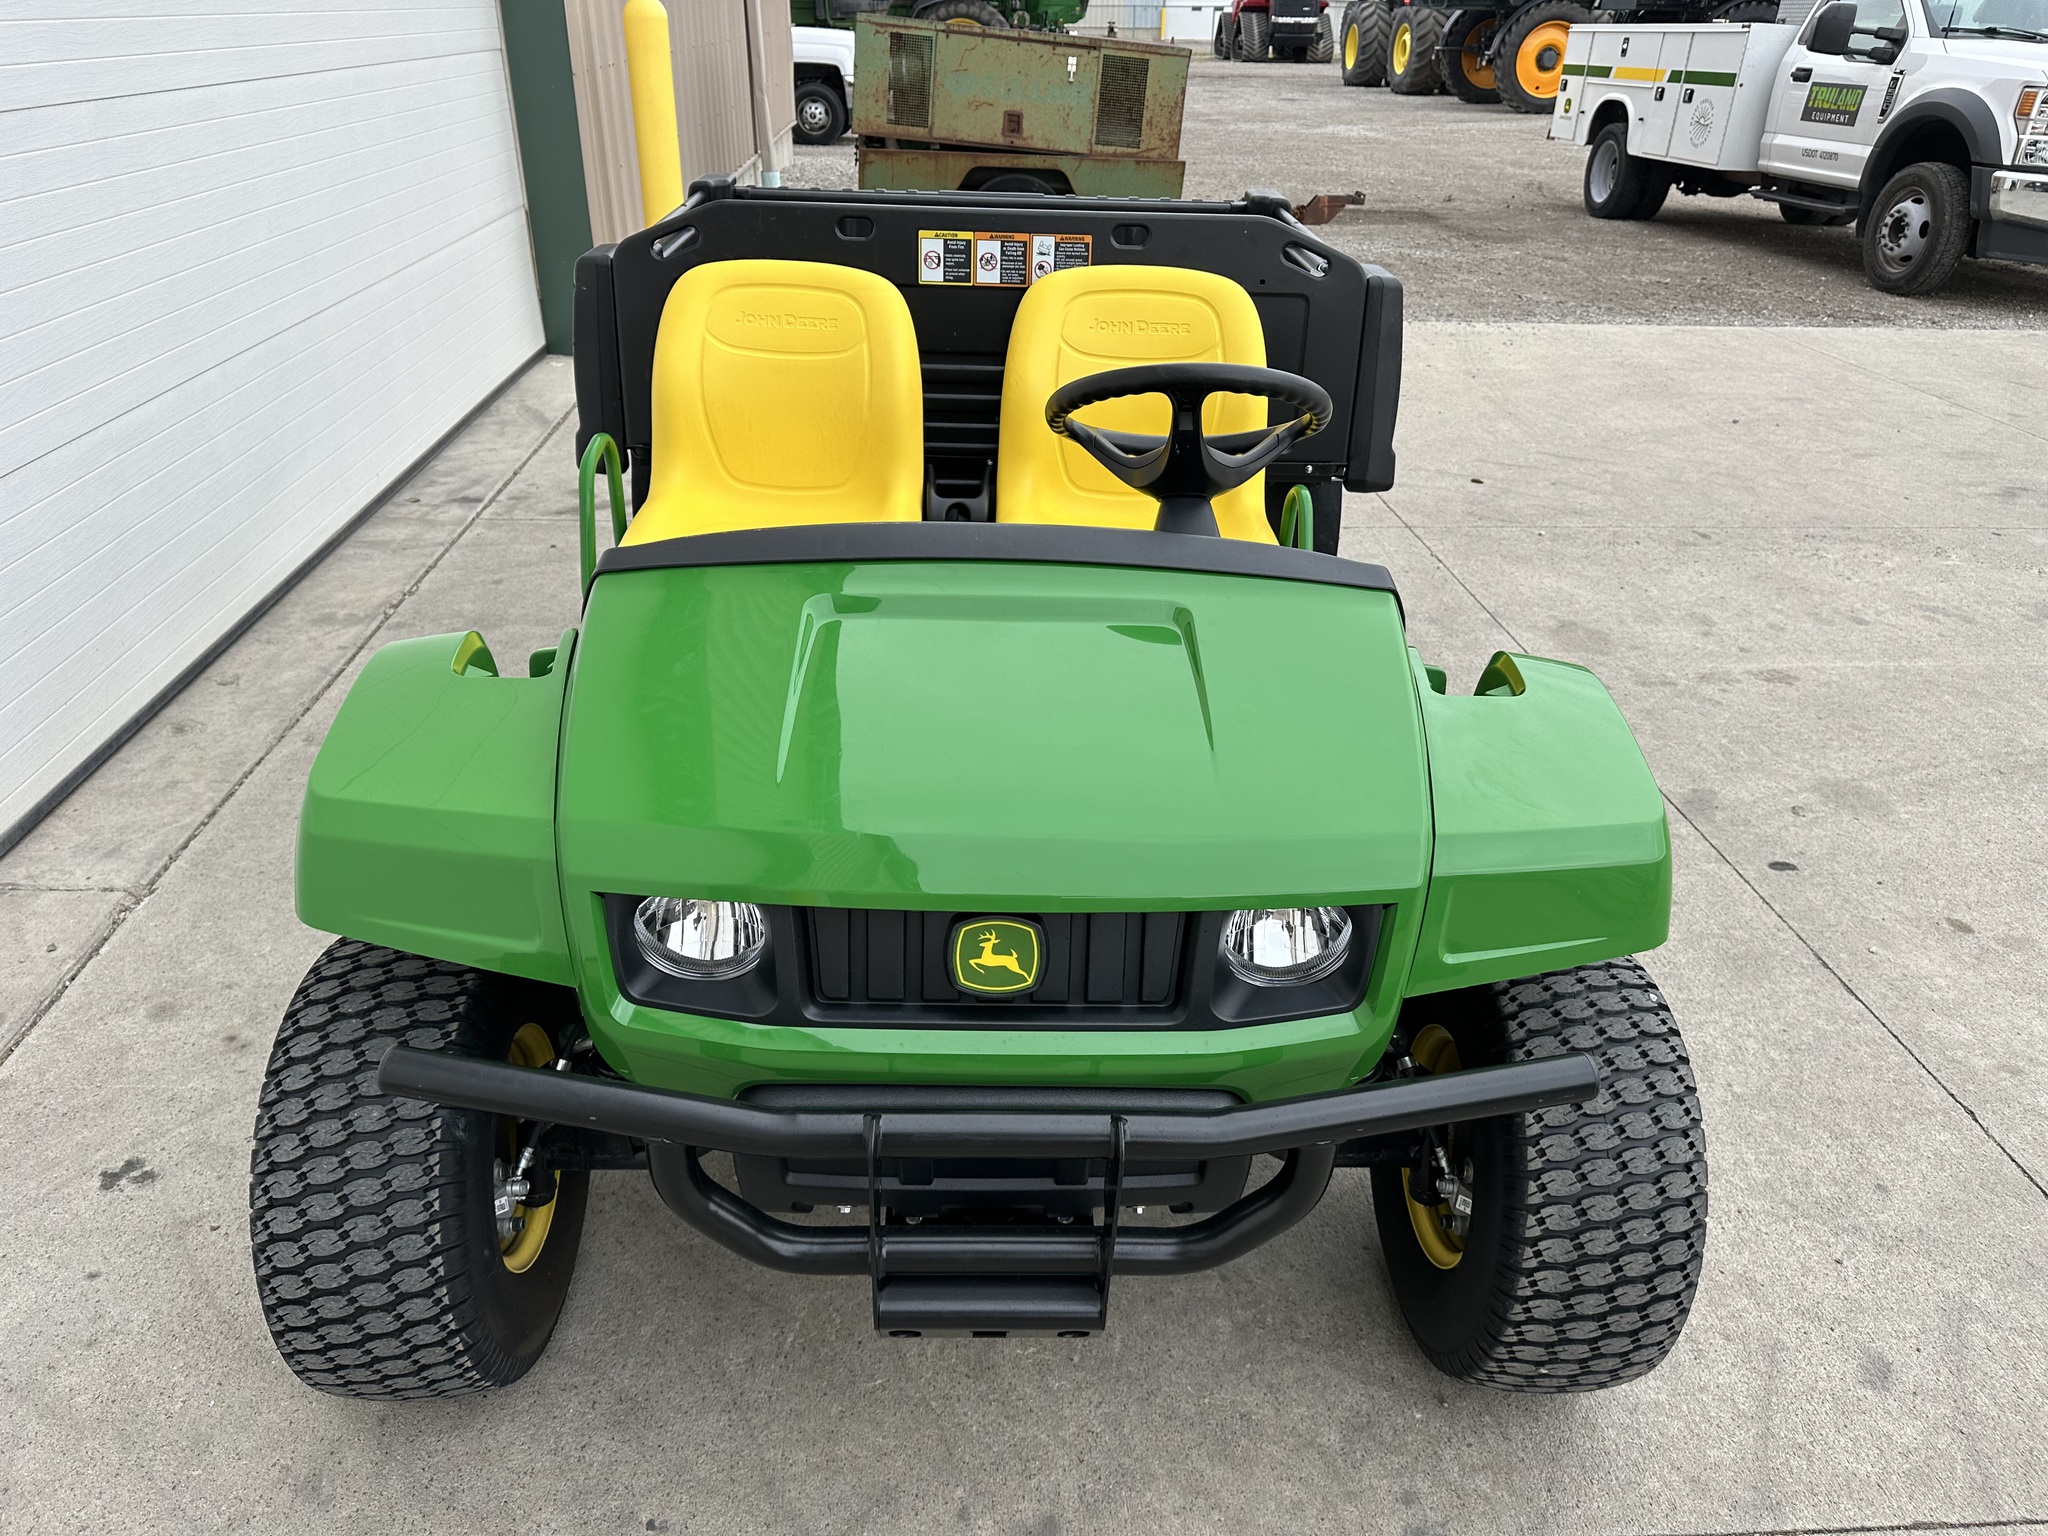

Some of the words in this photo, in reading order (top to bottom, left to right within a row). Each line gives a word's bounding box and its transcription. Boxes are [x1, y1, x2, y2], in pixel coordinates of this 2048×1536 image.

[1808, 86, 1864, 111] TRULAND
[1811, 111, 1850, 124] EQUIPMENT
[1801, 148, 1818, 159] USDOT
[734, 310, 781, 328] JOHN
[782, 313, 838, 331] DEERE
[1088, 317, 1133, 334] JOHN
[1134, 319, 1191, 336] DEERE
